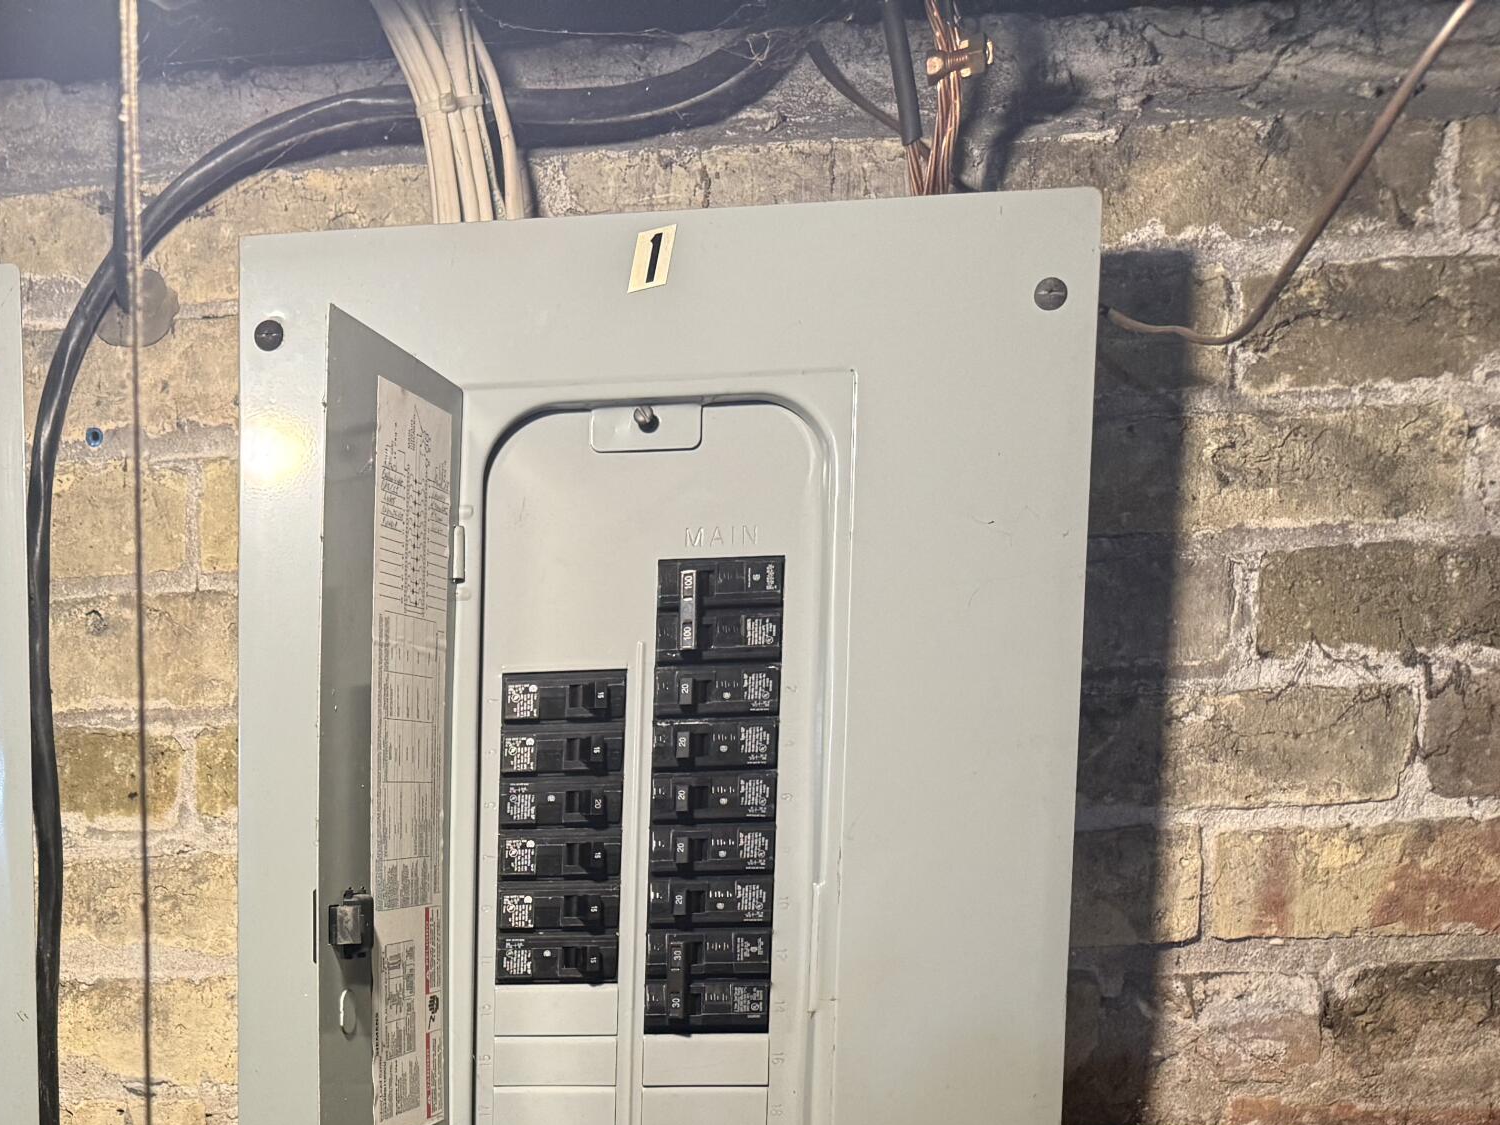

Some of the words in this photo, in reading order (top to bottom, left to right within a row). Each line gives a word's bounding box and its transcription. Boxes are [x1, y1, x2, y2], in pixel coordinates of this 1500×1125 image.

[645, 232, 663, 283] 1
[684, 525, 758, 547] MAIN
[684, 575, 692, 589] 100
[683, 626, 691, 640] 100
[681, 683, 689, 694] 20
[678, 737, 686, 748] 20
[677, 789, 685, 800] 20
[594, 798, 602, 809] 20
[676, 842, 684, 853] 20
[675, 894, 683, 905] 20
[673, 950, 682, 961] 30
[671, 997, 680, 1009] 30
